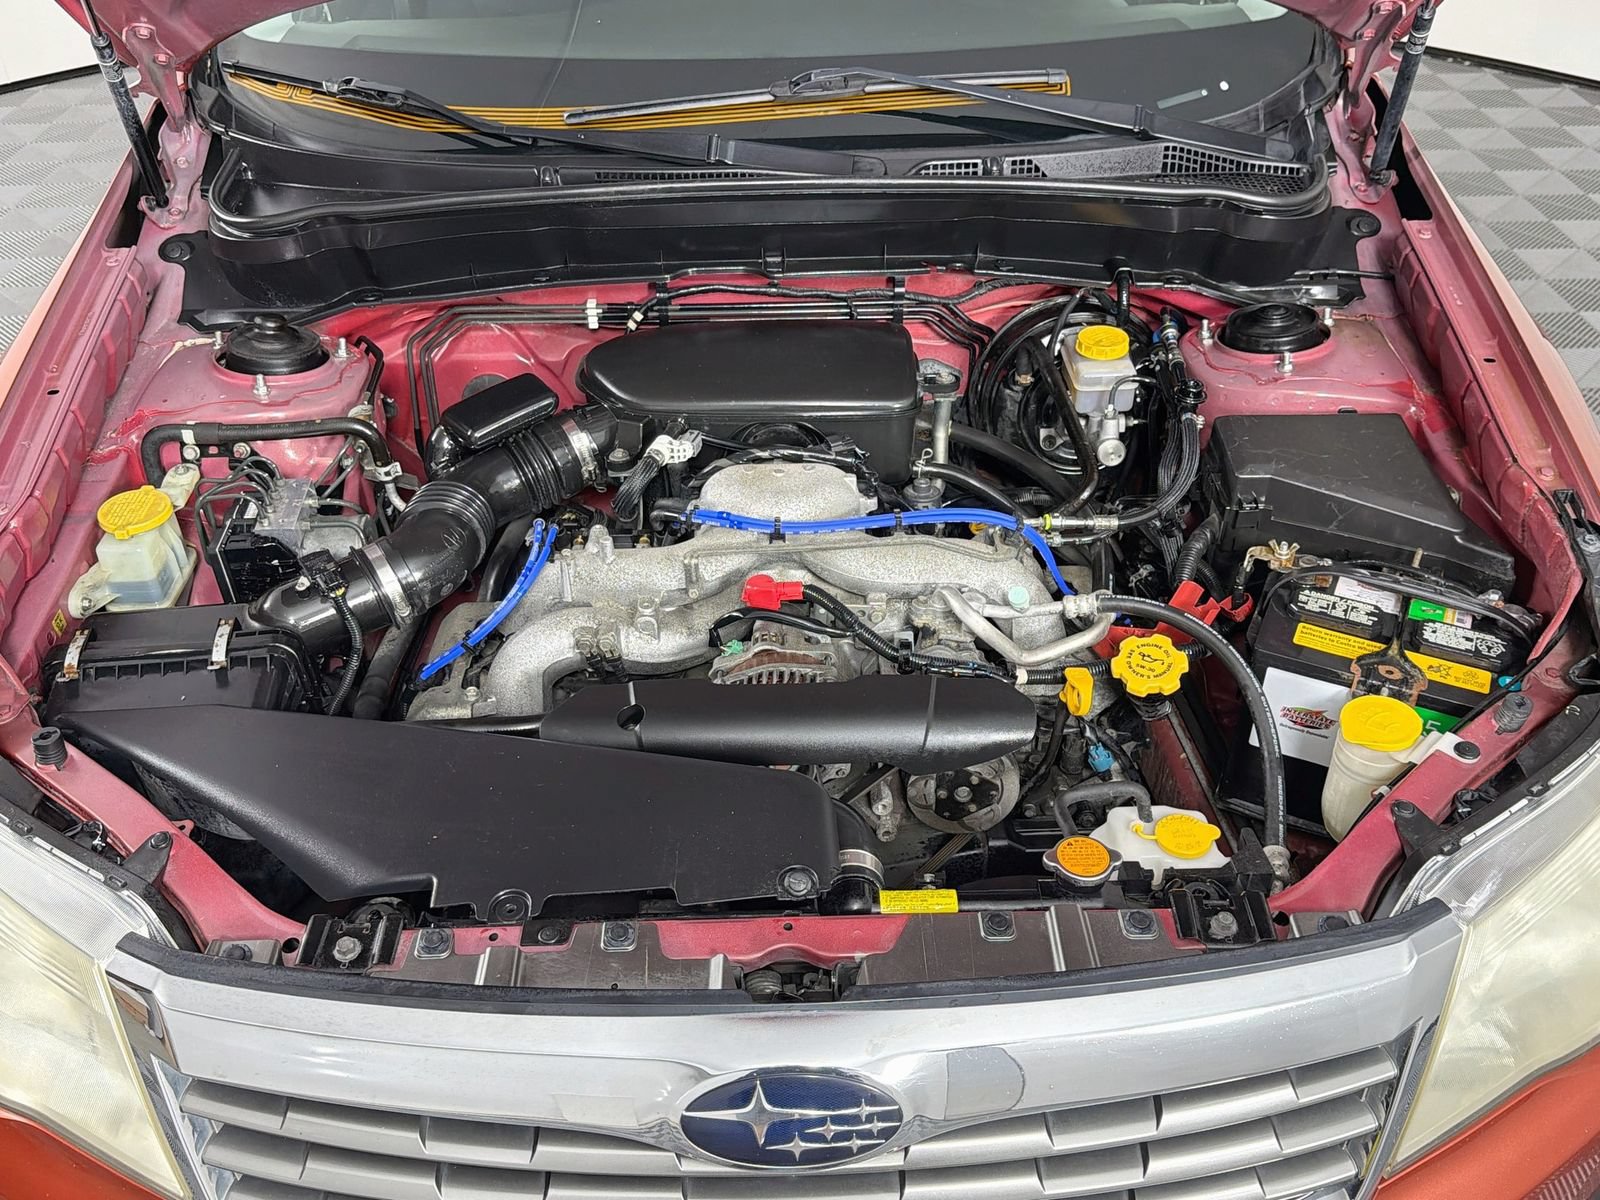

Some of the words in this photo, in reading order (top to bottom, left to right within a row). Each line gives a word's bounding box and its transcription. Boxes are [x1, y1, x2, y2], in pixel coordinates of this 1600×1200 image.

[1366, 641, 1382, 650] used
[1126, 649, 1135, 659] SEE
[1163, 649, 1171, 659] OIL
[1126, 660, 1151, 679] OWNER'S
[1135, 663, 1156, 673] 5W-30
[1152, 662, 1174, 679] MANUAL
[1280, 705, 1338, 727] INTERSTATE
[1280, 712, 1333, 730] BATTERIES
